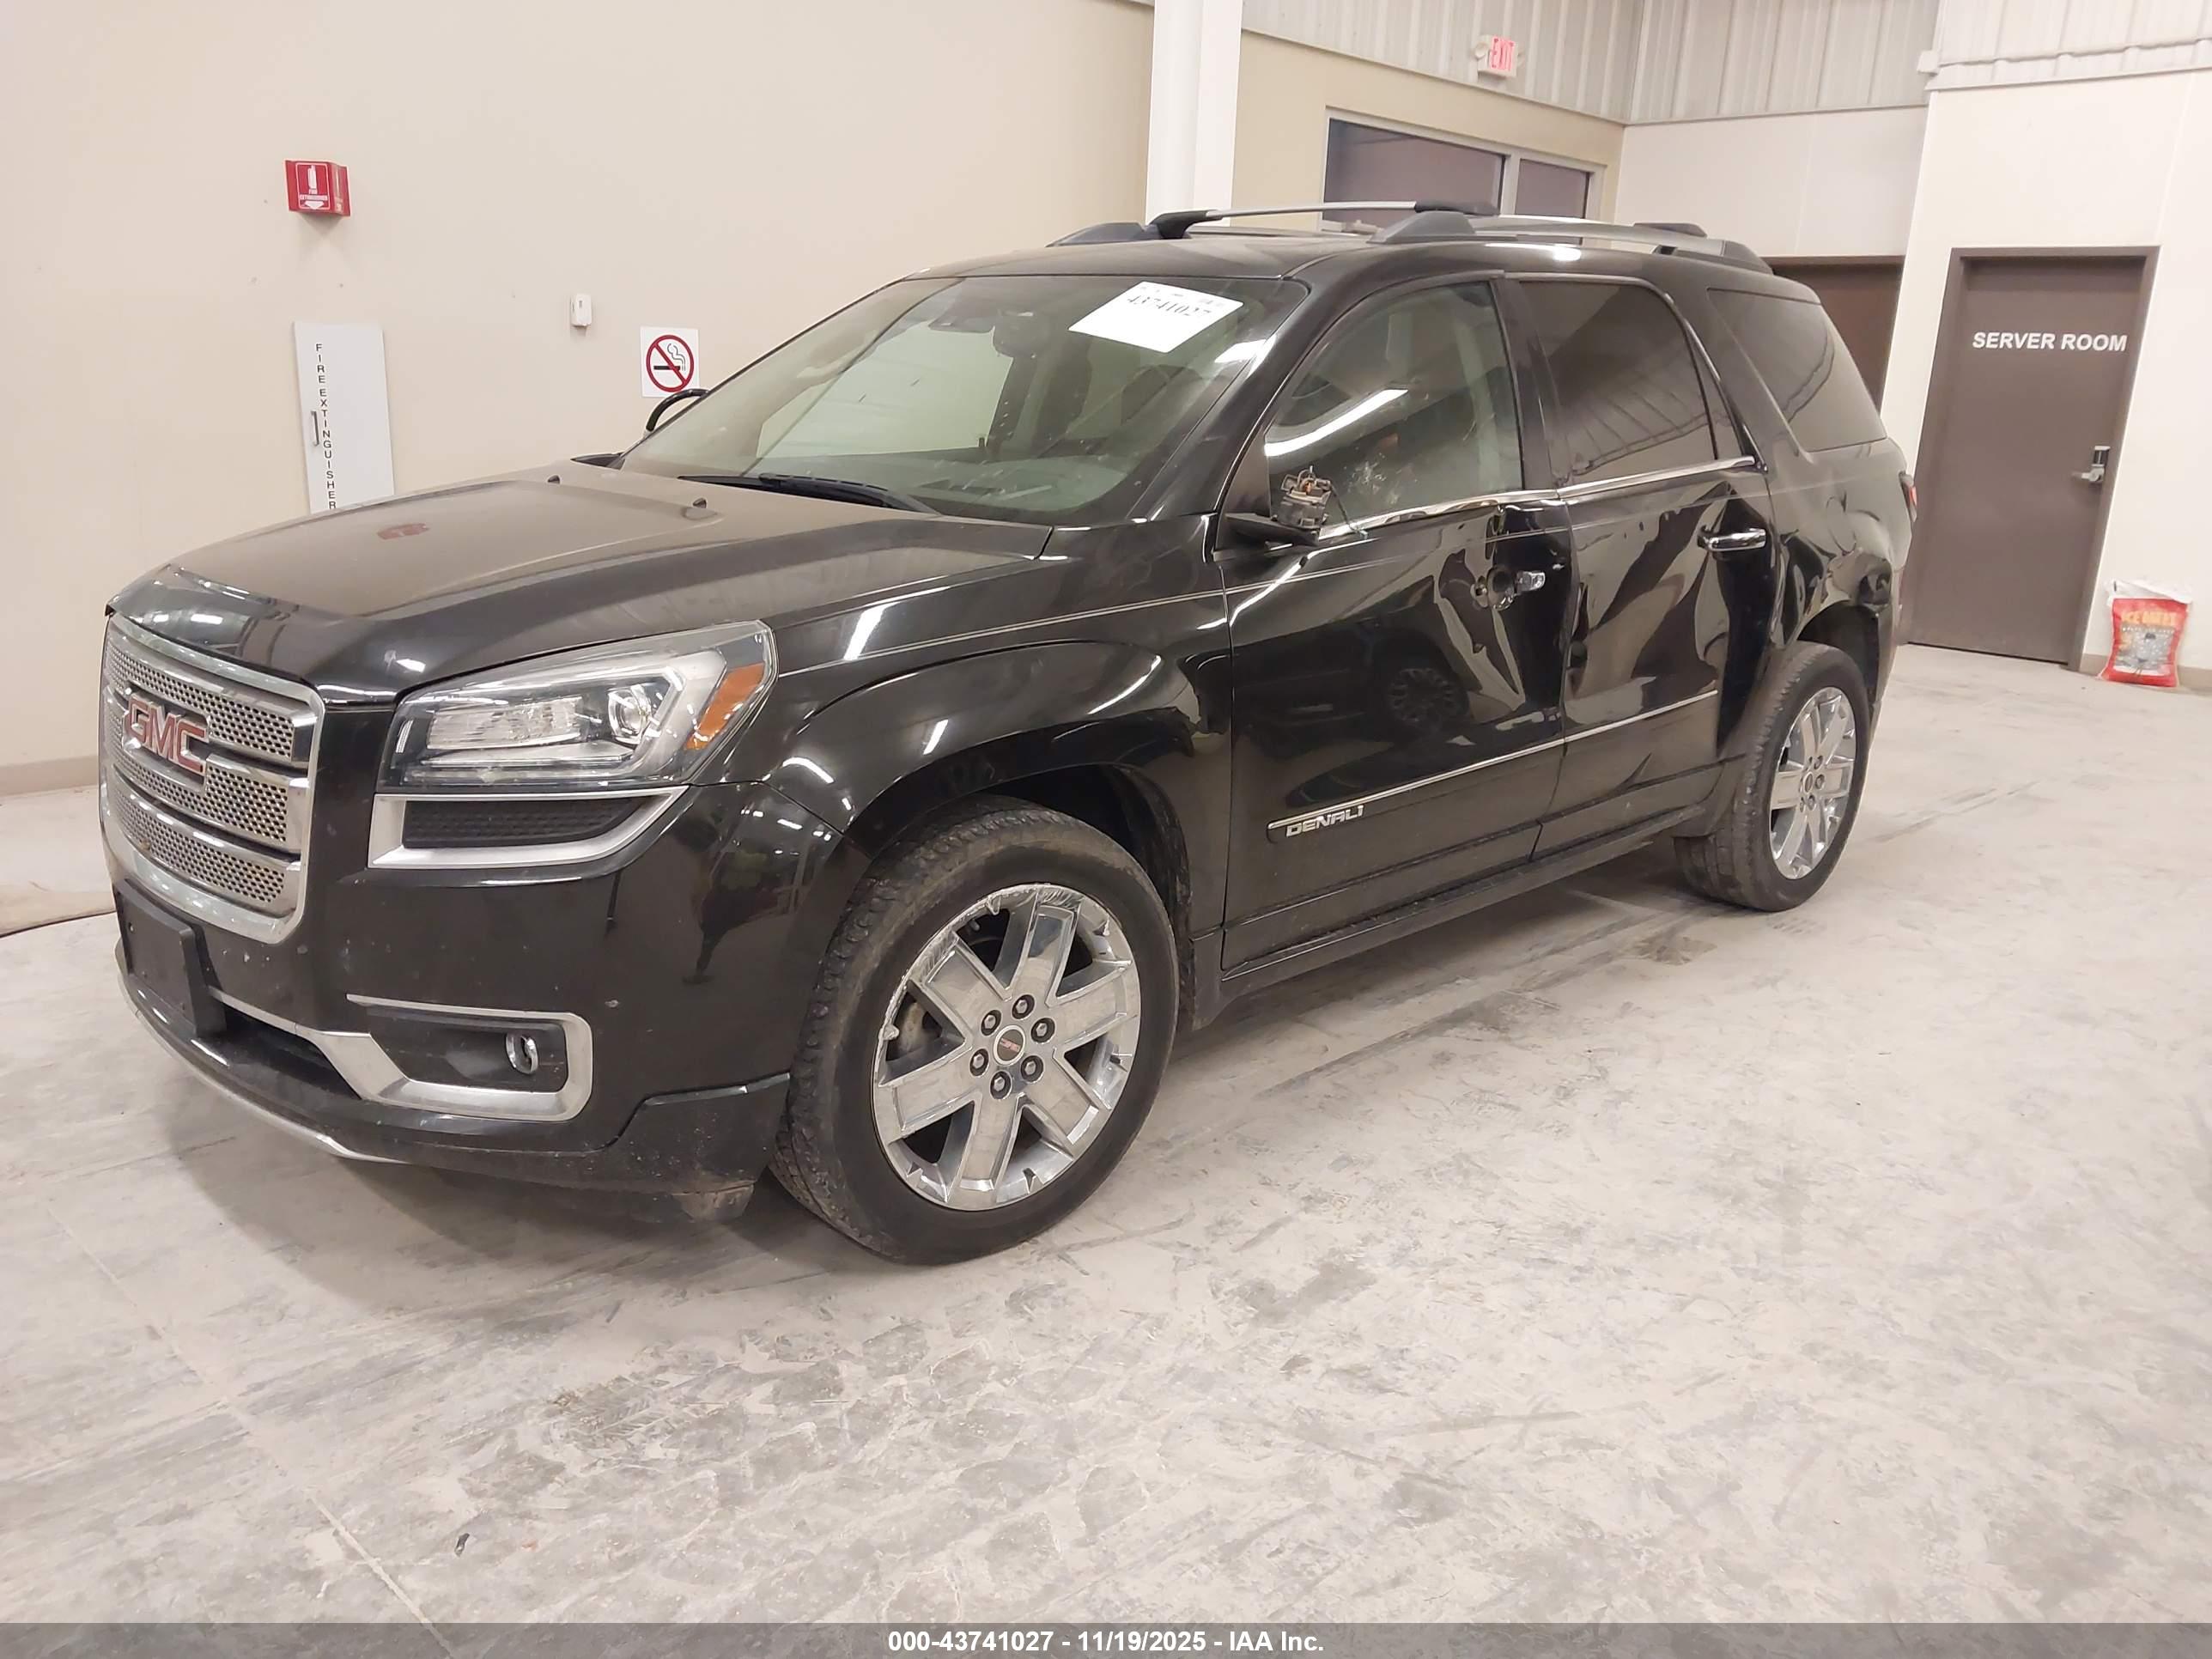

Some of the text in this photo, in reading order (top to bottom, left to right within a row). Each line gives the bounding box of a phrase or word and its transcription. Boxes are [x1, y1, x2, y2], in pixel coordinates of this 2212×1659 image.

[1491, 38, 1515, 70] EXIT
[1972, 331, 2128, 352] SERVER ROOM
[315, 343, 336, 509] FIRE EXTINGUISHER
[122, 694, 209, 776] GMC
[1285, 805, 1364, 837] DENALI
